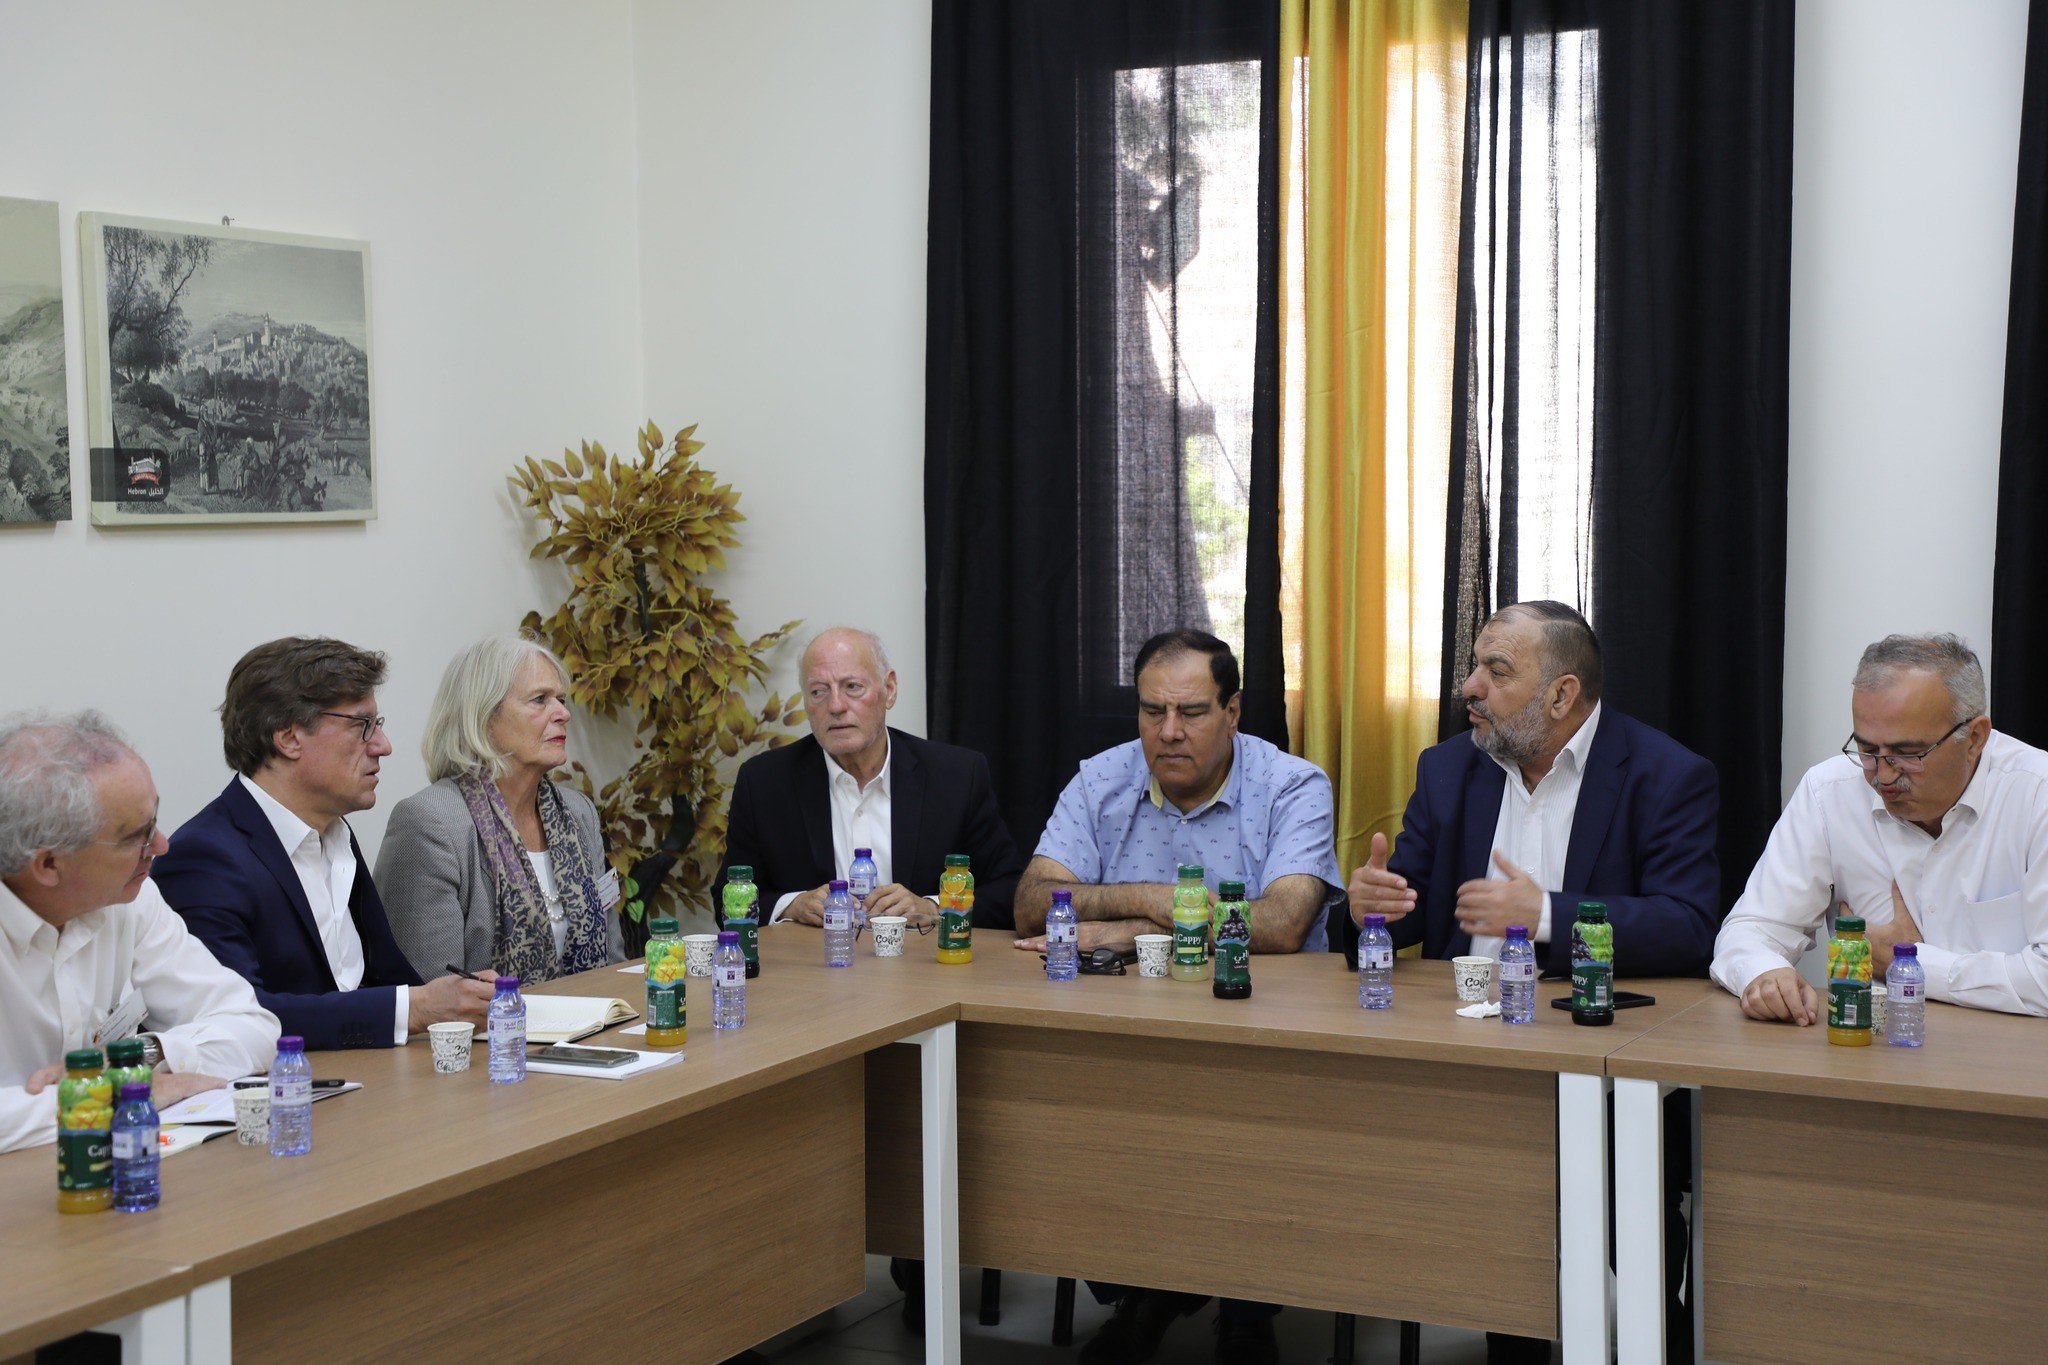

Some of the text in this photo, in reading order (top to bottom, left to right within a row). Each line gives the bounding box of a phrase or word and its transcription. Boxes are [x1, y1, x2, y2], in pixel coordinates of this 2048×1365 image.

[127, 487, 147, 495] Hebron
[148, 487, 164, 497] الخليل
[1177, 933, 1202, 945] Cappy
[1572, 974, 1588, 986] appy
